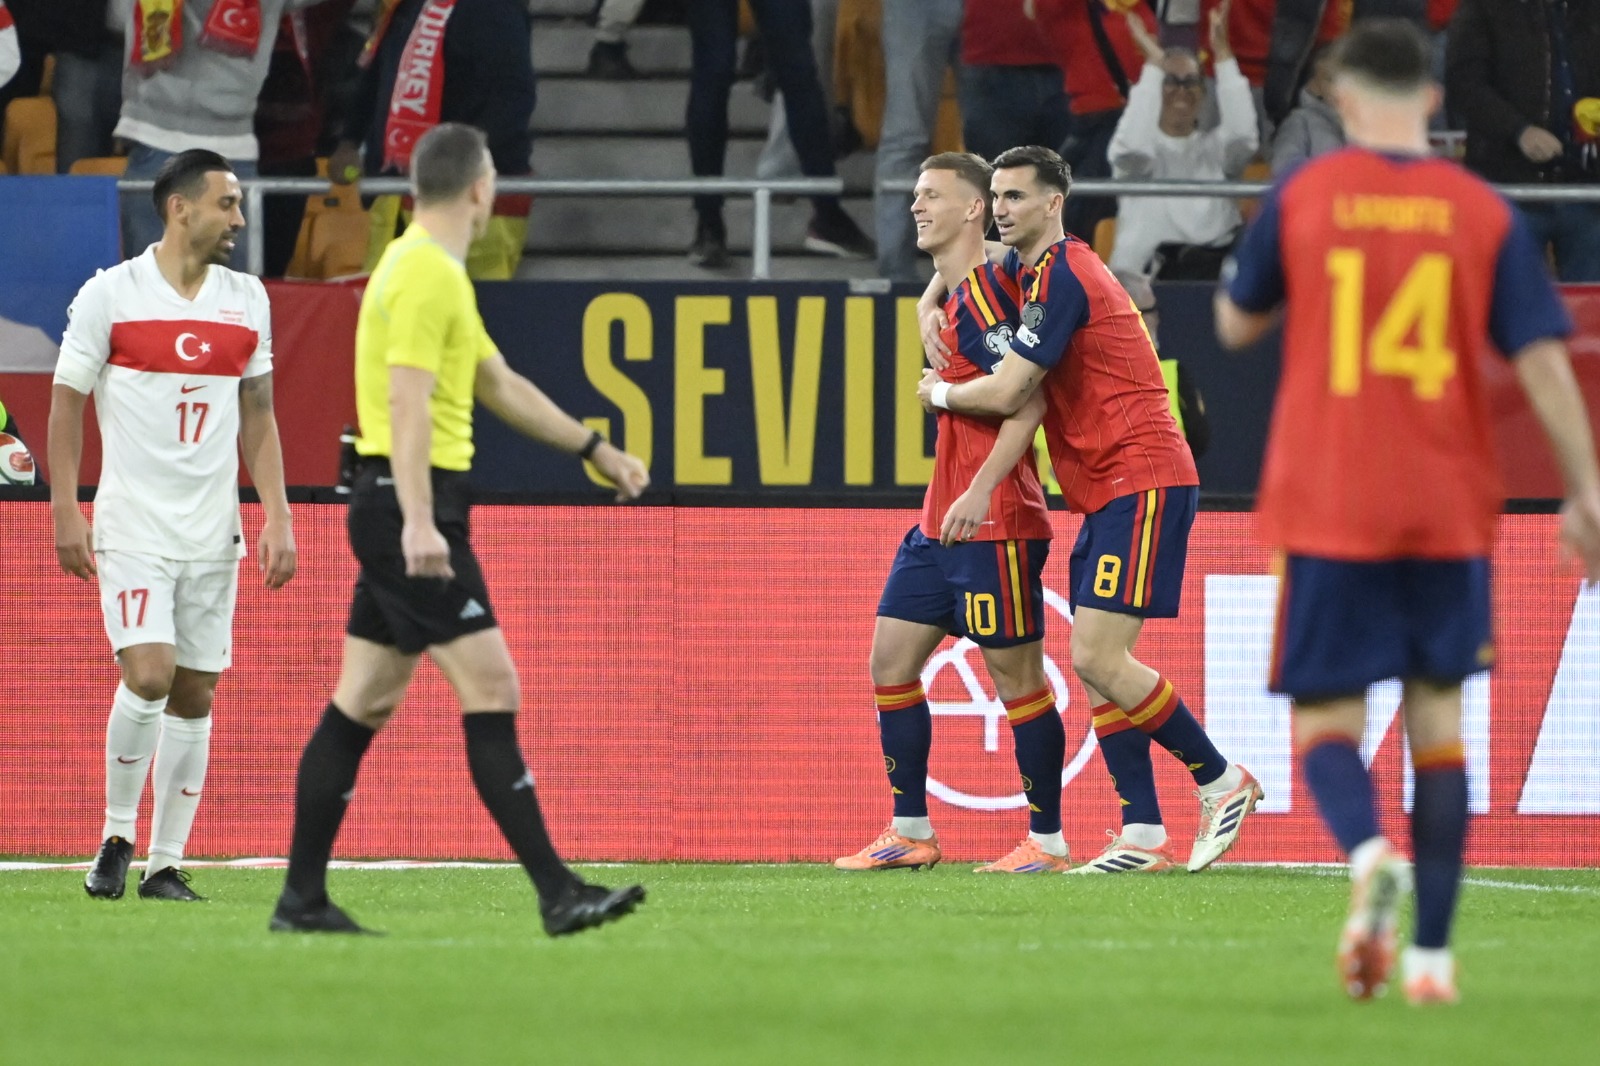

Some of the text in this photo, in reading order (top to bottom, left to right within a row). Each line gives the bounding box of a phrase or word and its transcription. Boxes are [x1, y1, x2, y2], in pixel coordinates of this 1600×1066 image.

[398, 1, 455, 115] TURKEY
[1326, 248, 1457, 399] 14
[176, 402, 209, 443] 17
[1094, 554, 1122, 598] 8
[117, 588, 149, 628] 17
[965, 592, 997, 636] 10
